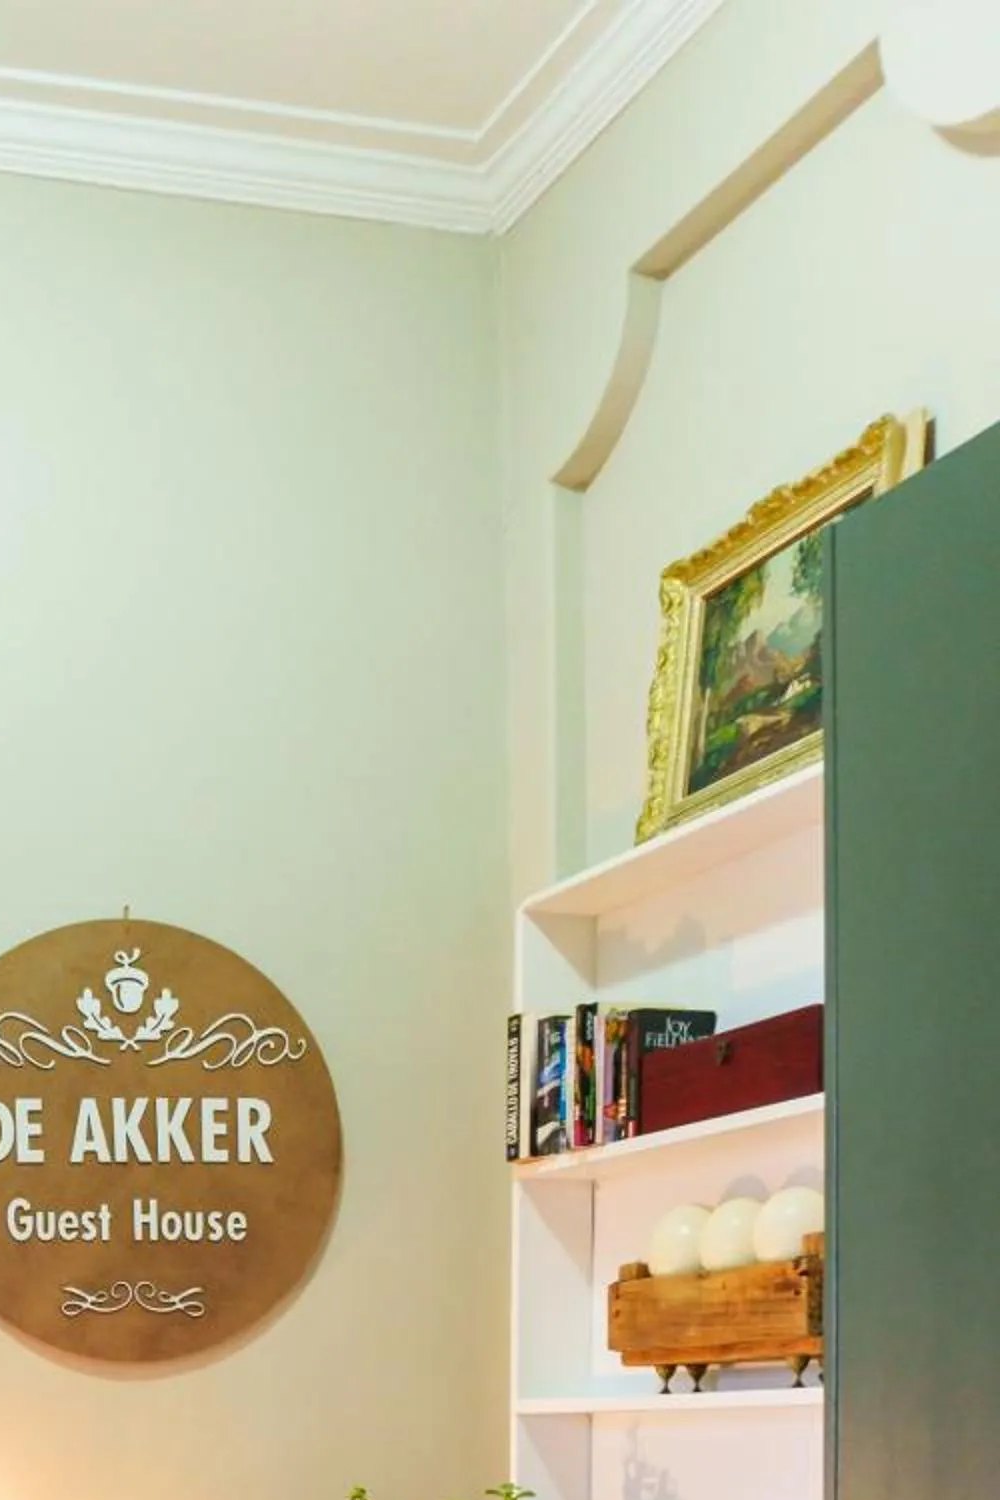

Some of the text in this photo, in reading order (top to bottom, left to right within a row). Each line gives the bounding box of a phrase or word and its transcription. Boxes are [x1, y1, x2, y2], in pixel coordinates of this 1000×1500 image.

[70, 1097, 275, 1164] AKKER
[6, 1197, 248, 1243] Guest House
